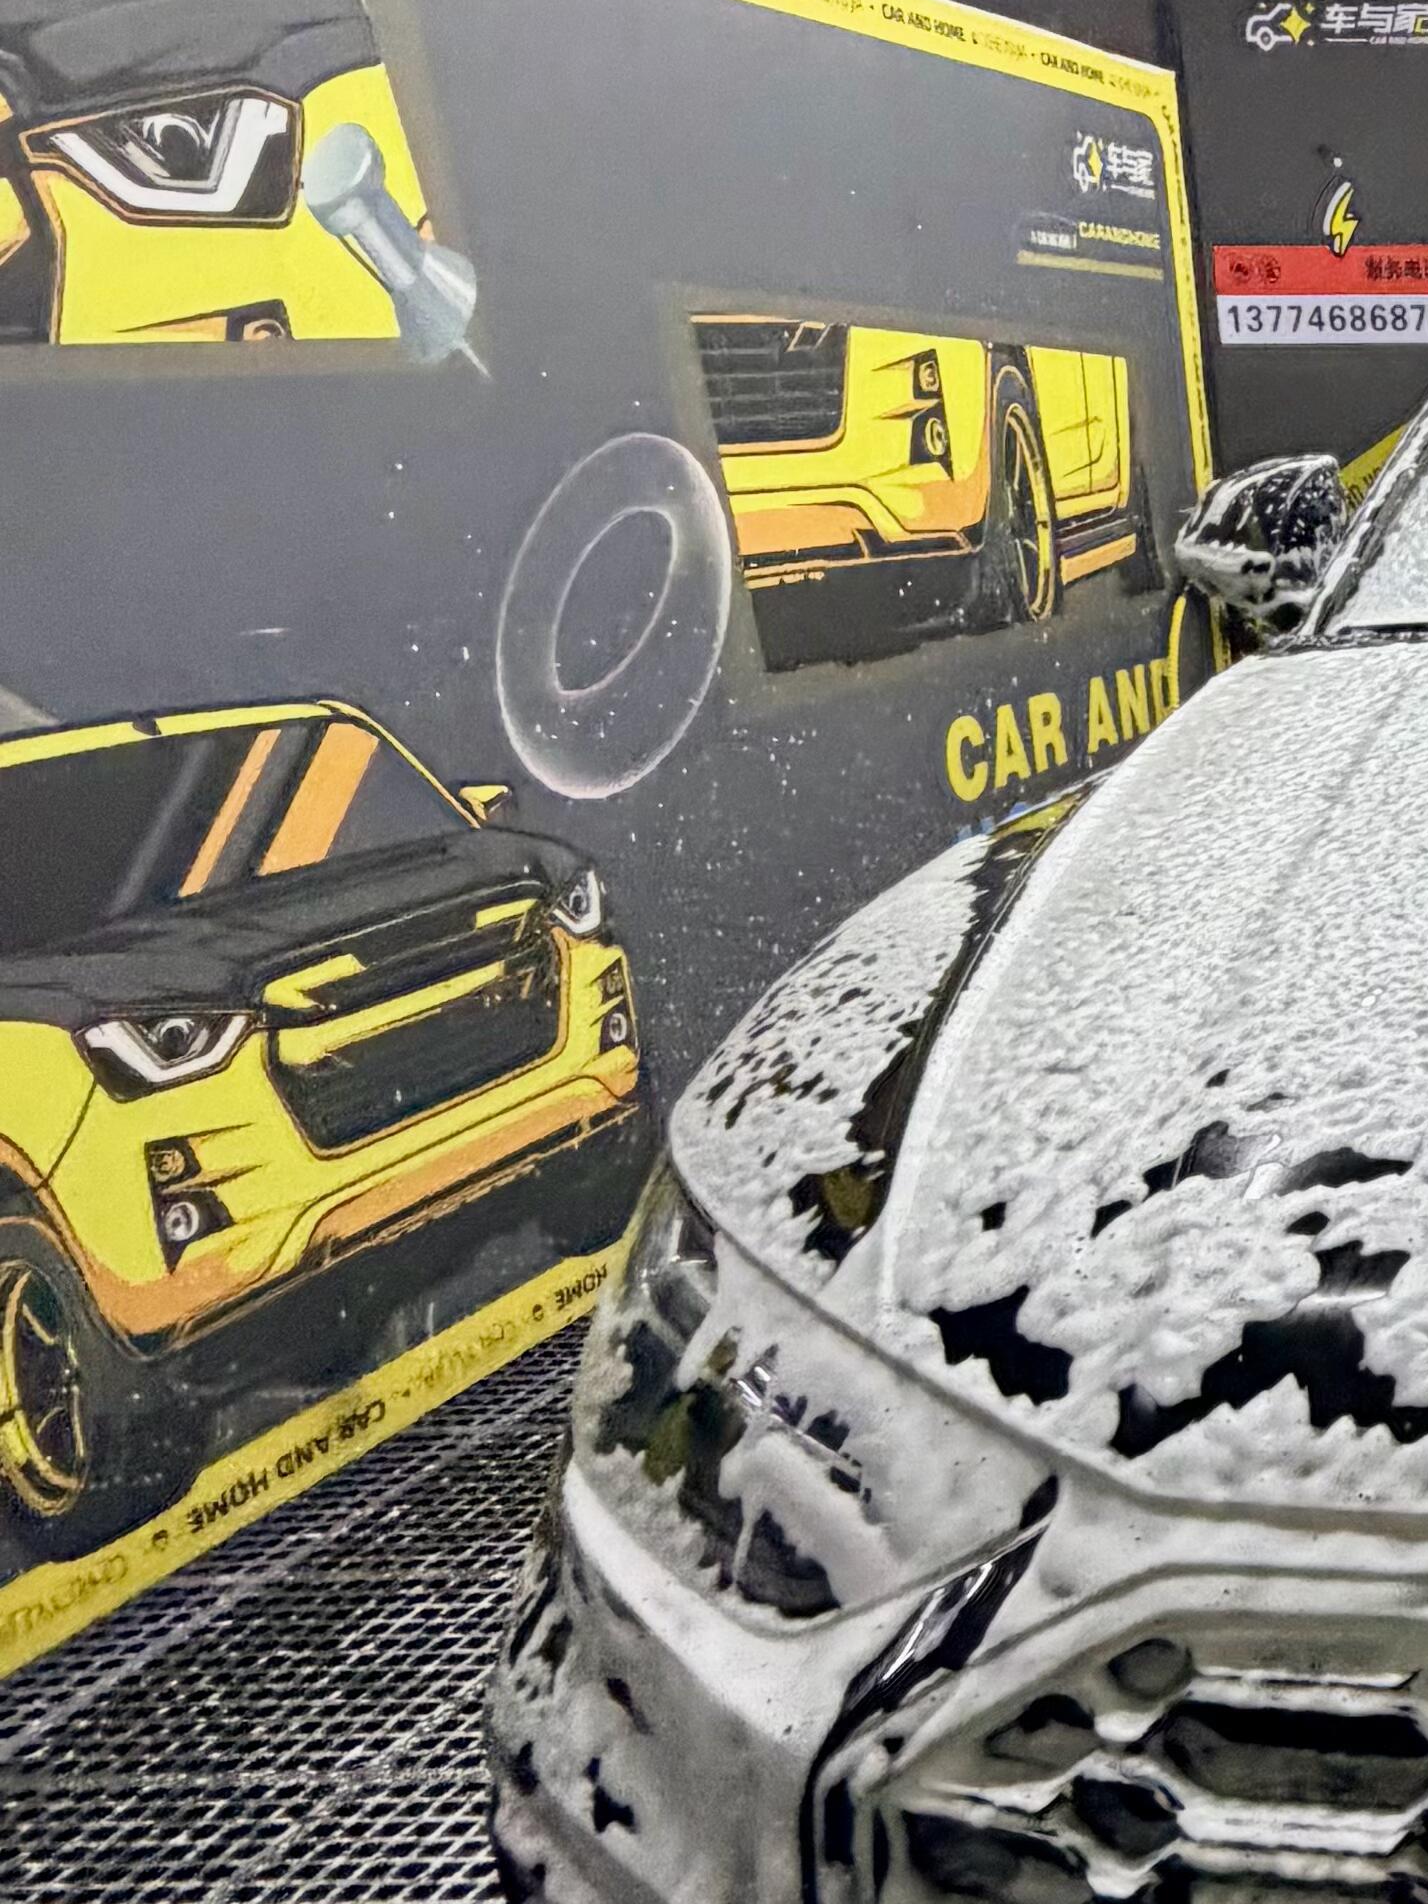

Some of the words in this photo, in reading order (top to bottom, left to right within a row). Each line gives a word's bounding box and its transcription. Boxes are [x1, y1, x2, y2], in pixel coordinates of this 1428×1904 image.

[945, 692, 1068, 802] CAR
[338, 1399, 387, 1442] CAR
[276, 1436, 330, 1479] AND
[186, 1467, 270, 1535] HOME
